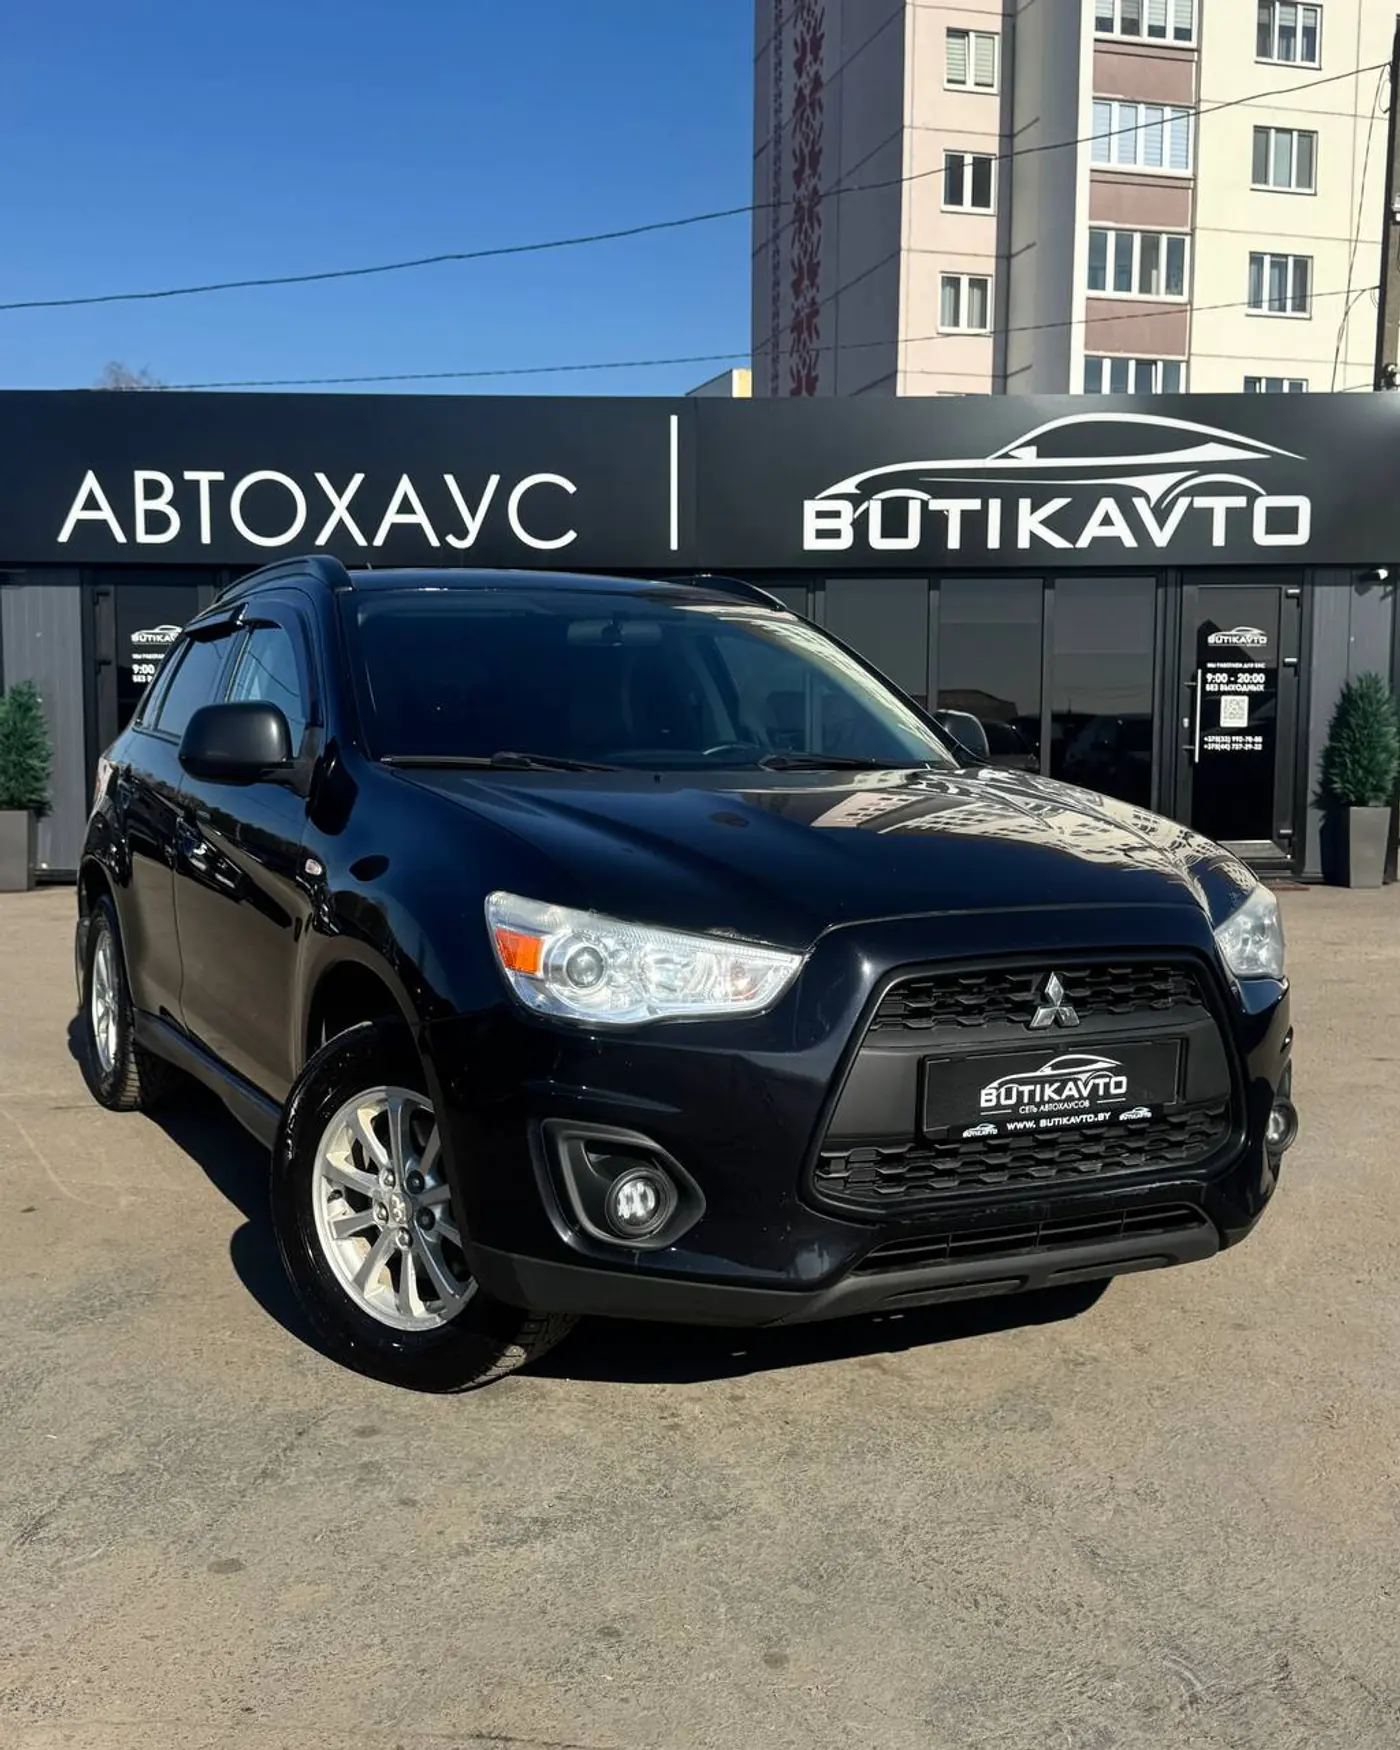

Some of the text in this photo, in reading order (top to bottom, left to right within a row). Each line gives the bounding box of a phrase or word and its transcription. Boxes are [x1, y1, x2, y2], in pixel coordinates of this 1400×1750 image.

[57, 469, 578, 550] АВТОХАУС
[803, 495, 1311, 550] BUTIKAVTO
[1207, 635, 1267, 644] BUTIKAVTO
[132, 664, 155, 674] 9:00
[1206, 673, 1228, 683] 9:00
[1237, 673, 1265, 683] 20:00
[1220, 684, 1265, 692] ВЫХОДНЫХ
[980, 1076, 1127, 1107] BUTIKAVTO
[1019, 1100, 1090, 1114] СЕТЬ АВТОХАУСОВ
[1039, 1112, 1111, 1128] BUTIKAVTO.BY
